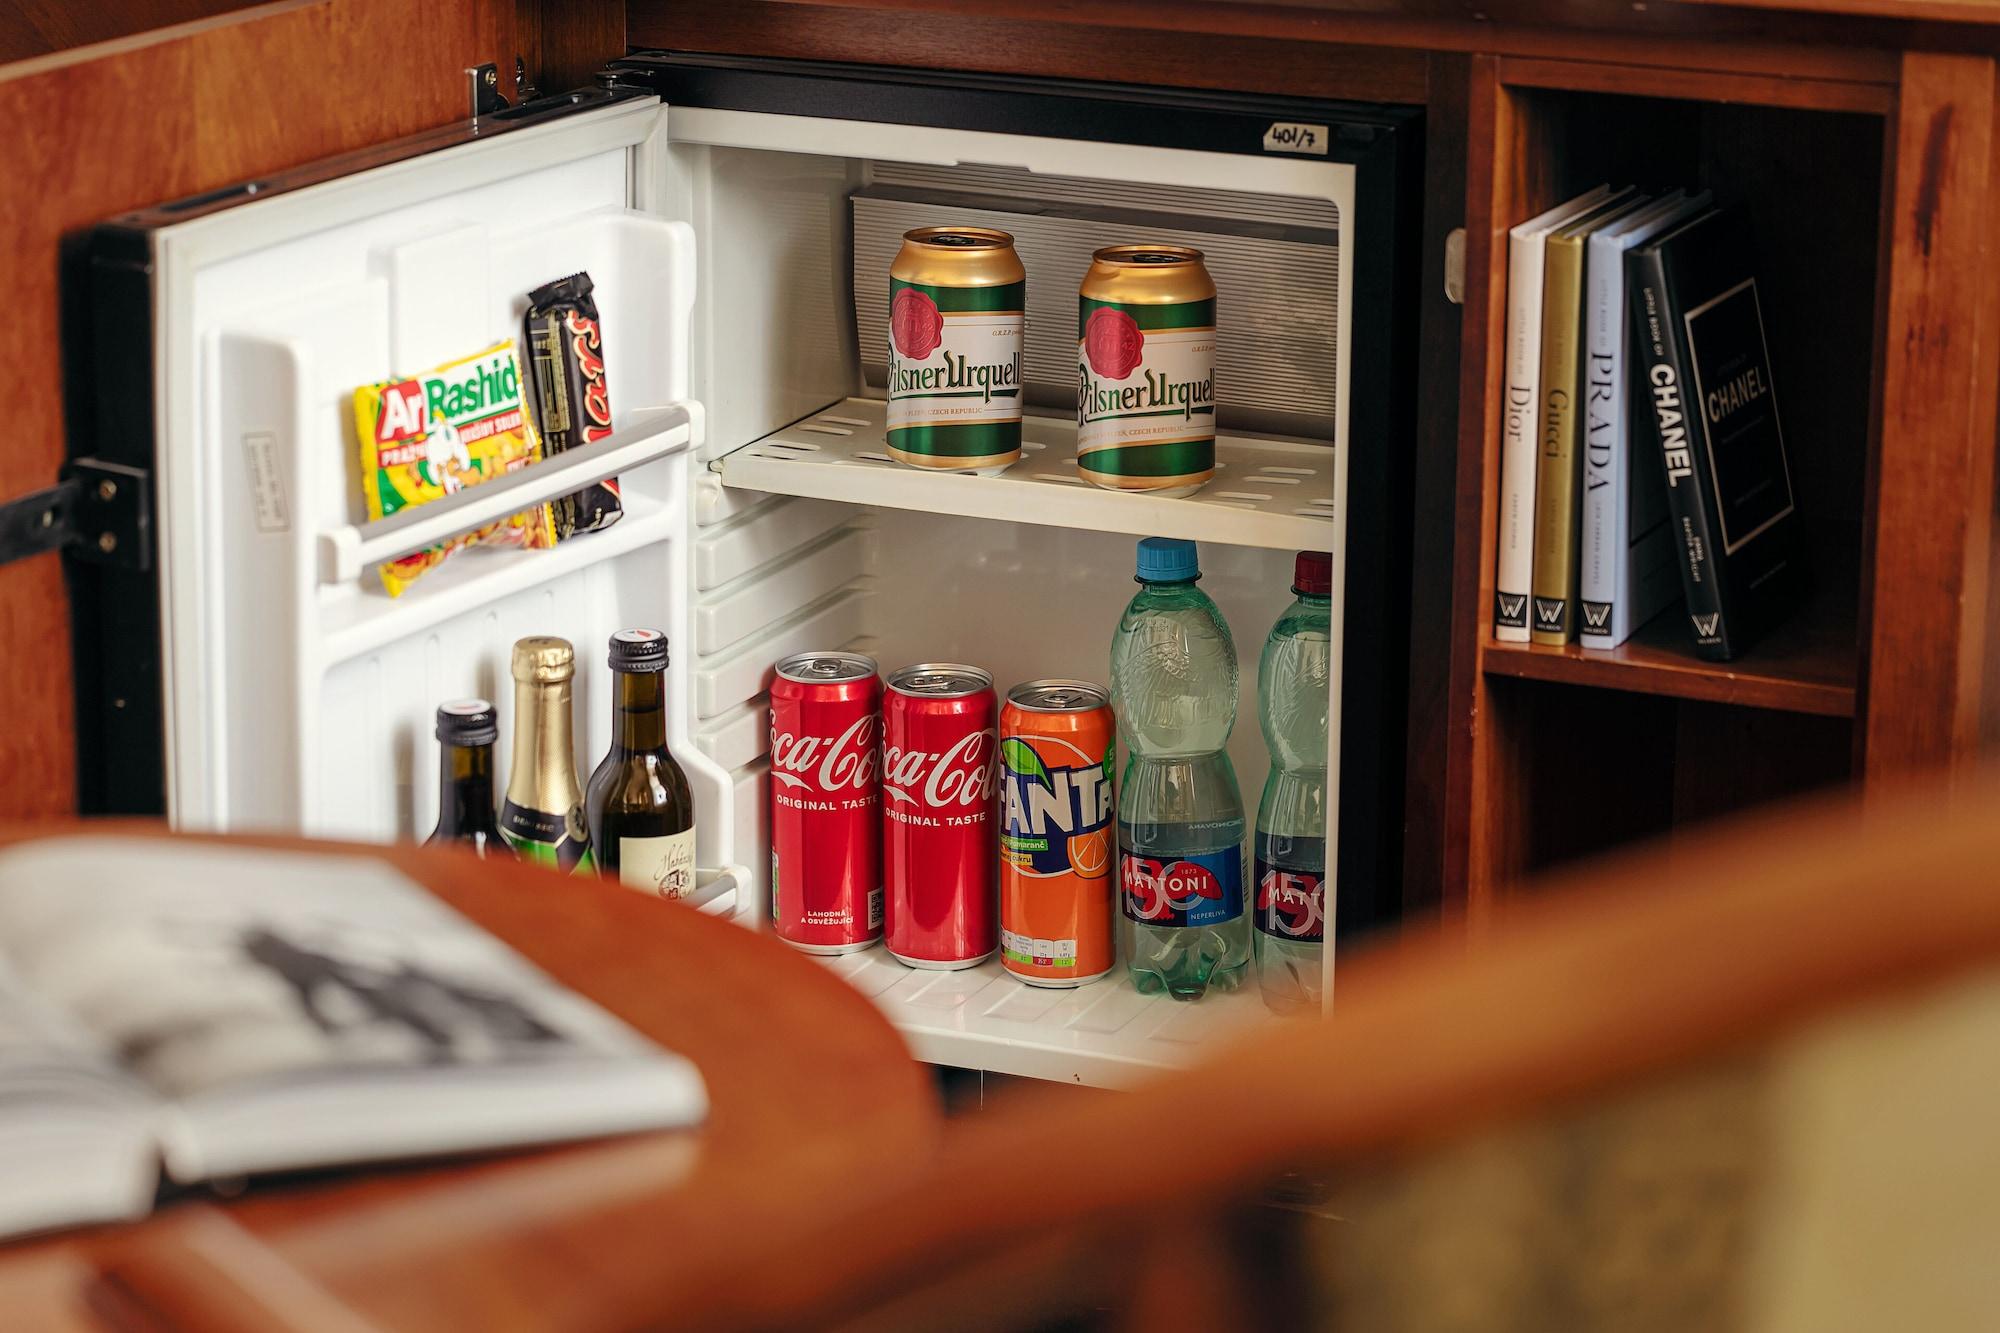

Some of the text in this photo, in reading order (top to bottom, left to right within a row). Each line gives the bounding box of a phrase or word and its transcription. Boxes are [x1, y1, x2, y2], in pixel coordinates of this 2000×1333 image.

[1272, 127, 1315, 148] 401/7
[380, 388, 424, 441] Ar
[424, 355, 519, 424] Rashid
[943, 350, 1020, 404] Urquell
[1708, 365, 1767, 424] CHANEL
[928, 407, 949, 416] CZECH
[950, 407, 983, 415] REPUBLIC
[1508, 385, 1531, 442] Dior
[1546, 388, 1568, 459] Gucci
[1588, 352, 1614, 491] PRADA
[1651, 363, 1692, 488] CHANEL
[776, 794, 878, 811] ORIGINAL TASTE
[885, 807, 986, 827] ORIGINAL TASTE
[1124, 870, 1208, 892] MATTONI
[1268, 884, 1324, 906] MATT
